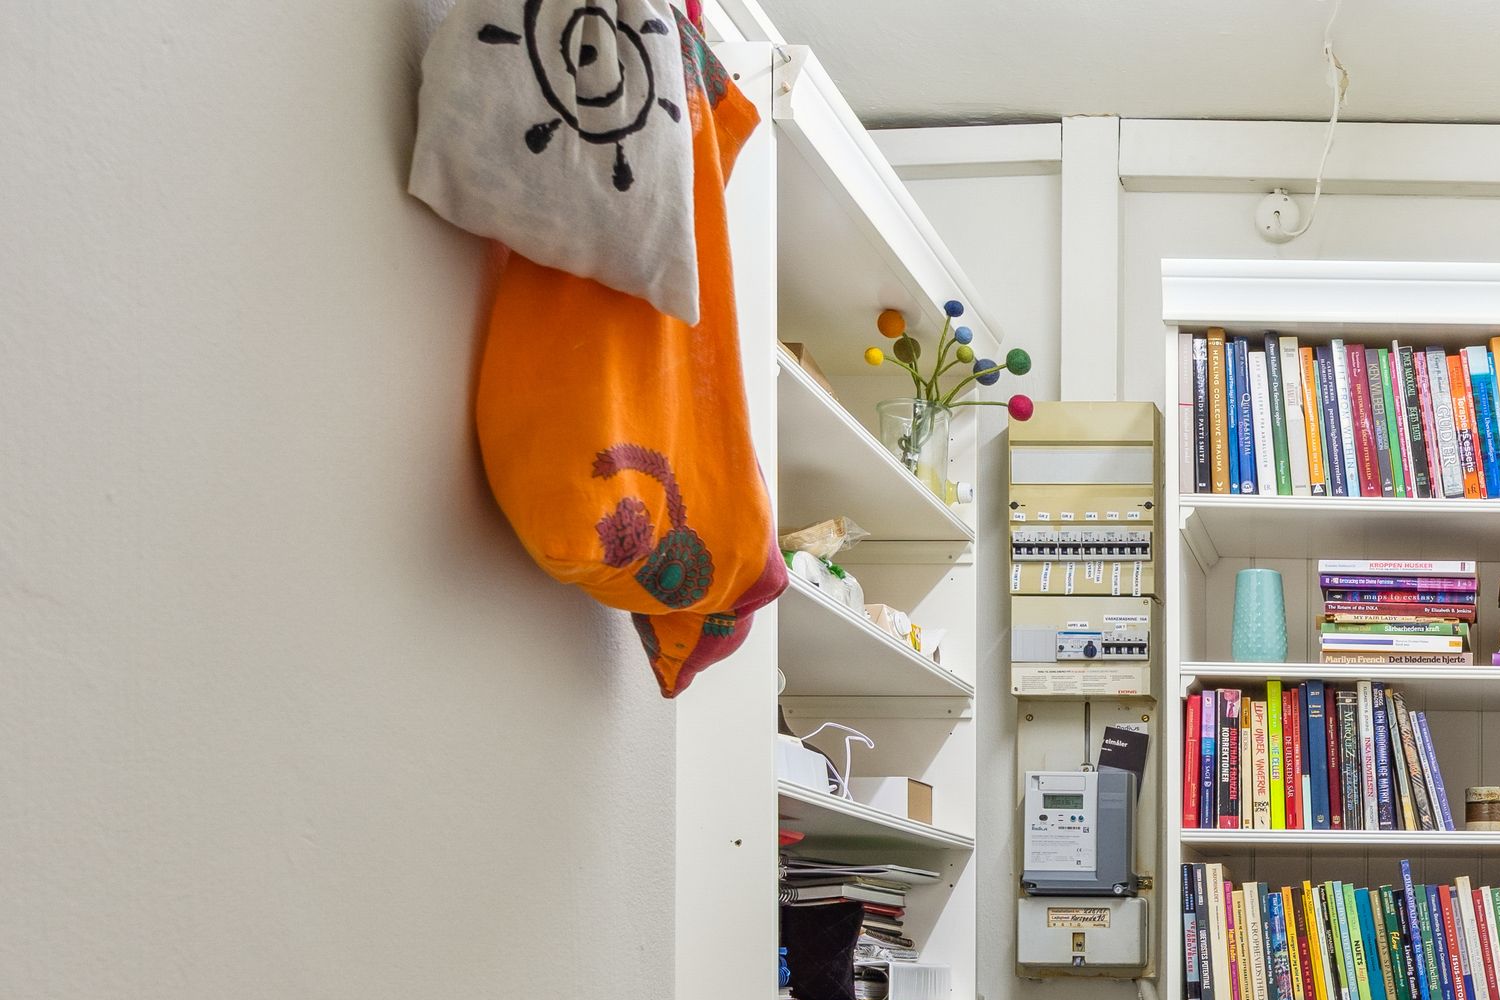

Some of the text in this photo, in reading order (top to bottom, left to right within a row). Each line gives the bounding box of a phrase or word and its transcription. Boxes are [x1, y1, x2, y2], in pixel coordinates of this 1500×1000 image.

[1212, 350, 1220, 386] HEALING
[1340, 387, 1349, 420] FROM
[1368, 363, 1384, 415] KEN WILBER
[1344, 426, 1355, 469] WITHIN
[1436, 404, 1457, 467] GUD ER
[1462, 441, 1475, 473] essens
[1325, 655, 1356, 664] Marilyn
[1442, 656, 1465, 664] hjerte
[1221, 727, 1229, 783] KORREKTIONER
[1254, 728, 1264, 754] UNDER
[1285, 736, 1292, 746] DE
[1375, 710, 1390, 803] DEN GUDDOMMELIGE MATRIX
[1229, 727, 1237, 800] JONATHAN FRANZEN
[1365, 737, 1373, 798] INKA-INDVIELSEN
[1354, 940, 1363, 966] NUETS
[1390, 931, 1400, 951] Flow
[1201, 960, 1210, 989] POTENTIALE
[1304, 961, 1313, 997] SIKKER
[1404, 944, 1418, 1000] Livsfarlig familie
[1425, 939, 1438, 990] Traumeheling
